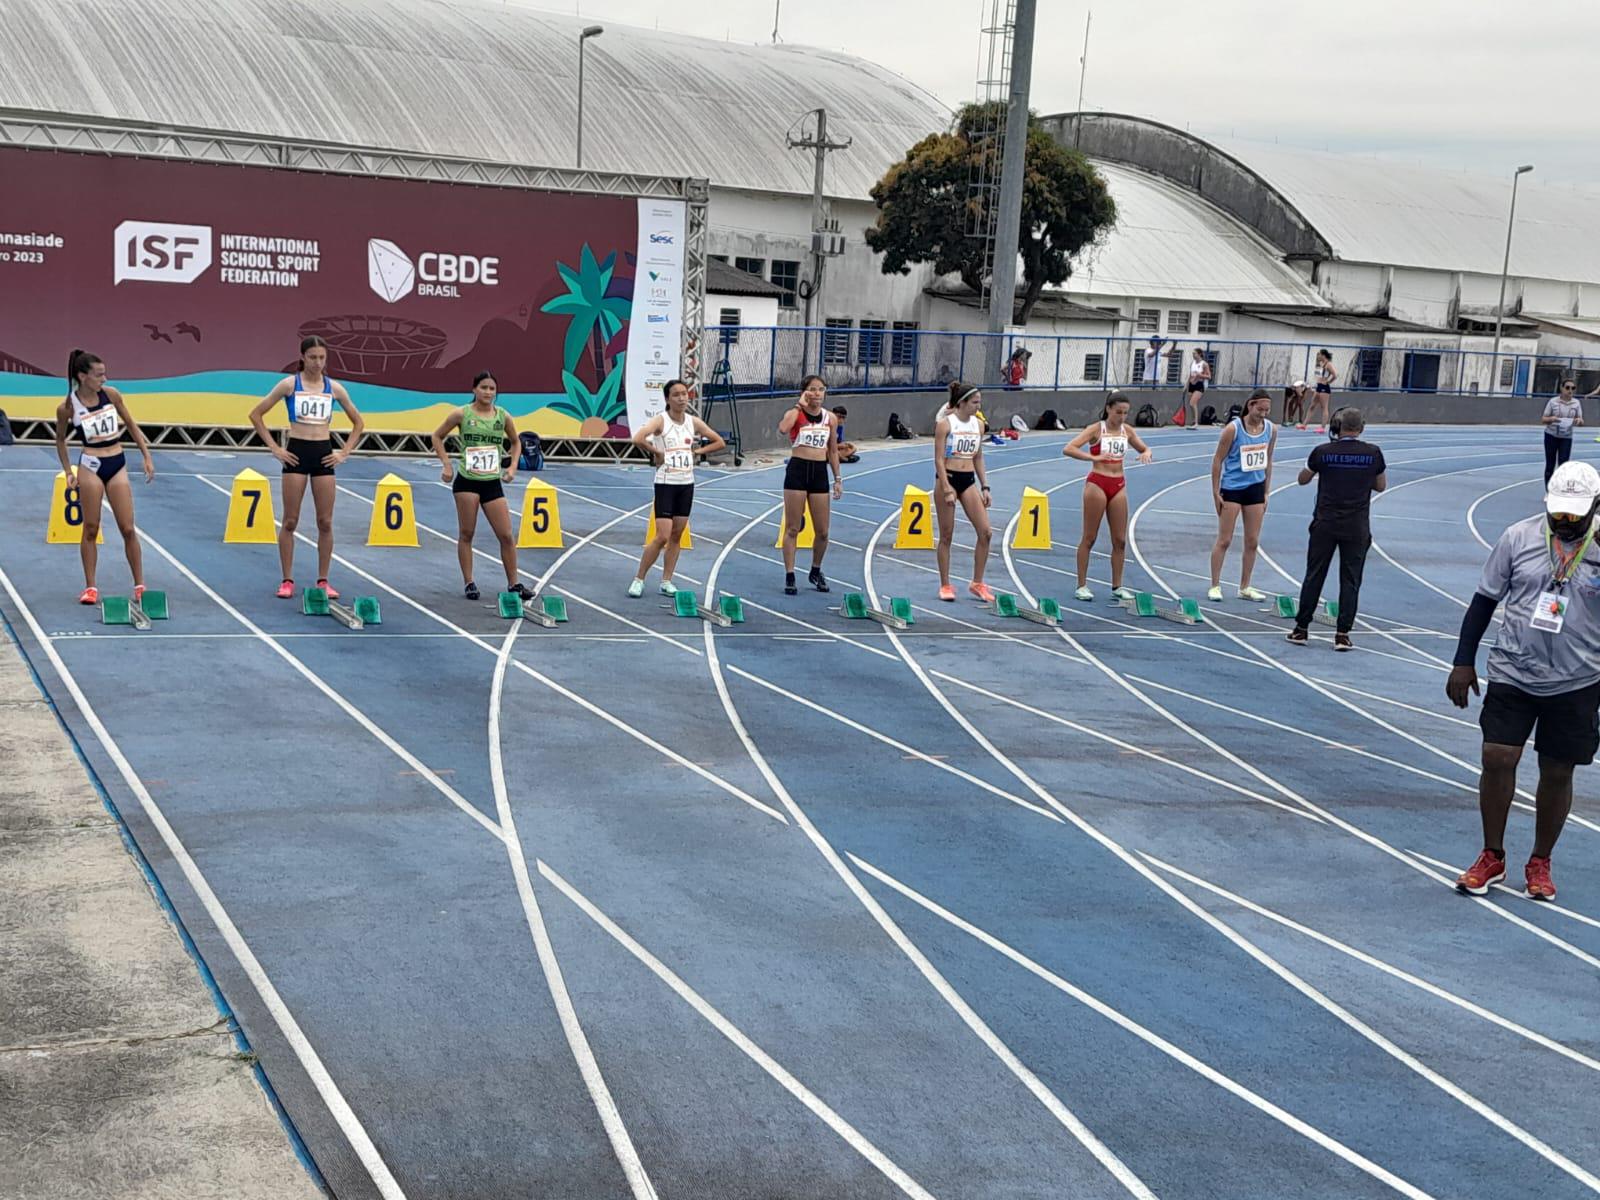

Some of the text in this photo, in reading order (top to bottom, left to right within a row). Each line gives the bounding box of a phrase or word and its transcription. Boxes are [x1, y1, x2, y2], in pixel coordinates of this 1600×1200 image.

[128, 234, 200, 270] ISF
[221, 234, 320, 256] INTERNATIONAL
[13, 251, 44, 263] 2023
[221, 251, 320, 272] SCHOOL SPORT
[221, 268, 299, 287] FEDERATION
[418, 252, 499, 286] CBDE
[418, 283, 462, 298] BRASIL
[301, 400, 325, 418] 041
[90, 415, 116, 437] 147
[956, 438, 977, 454] 005
[1107, 439, 1125, 455] 194
[472, 454, 494, 470] 217
[671, 455, 689, 468] 114
[1246, 452, 1265, 467] 079
[65, 487, 83, 526] 8
[242, 490, 261, 527] 7
[385, 492, 403, 531] 6
[532, 497, 549, 534] 5
[908, 501, 924, 535] 2
[1028, 504, 1039, 537] 1
